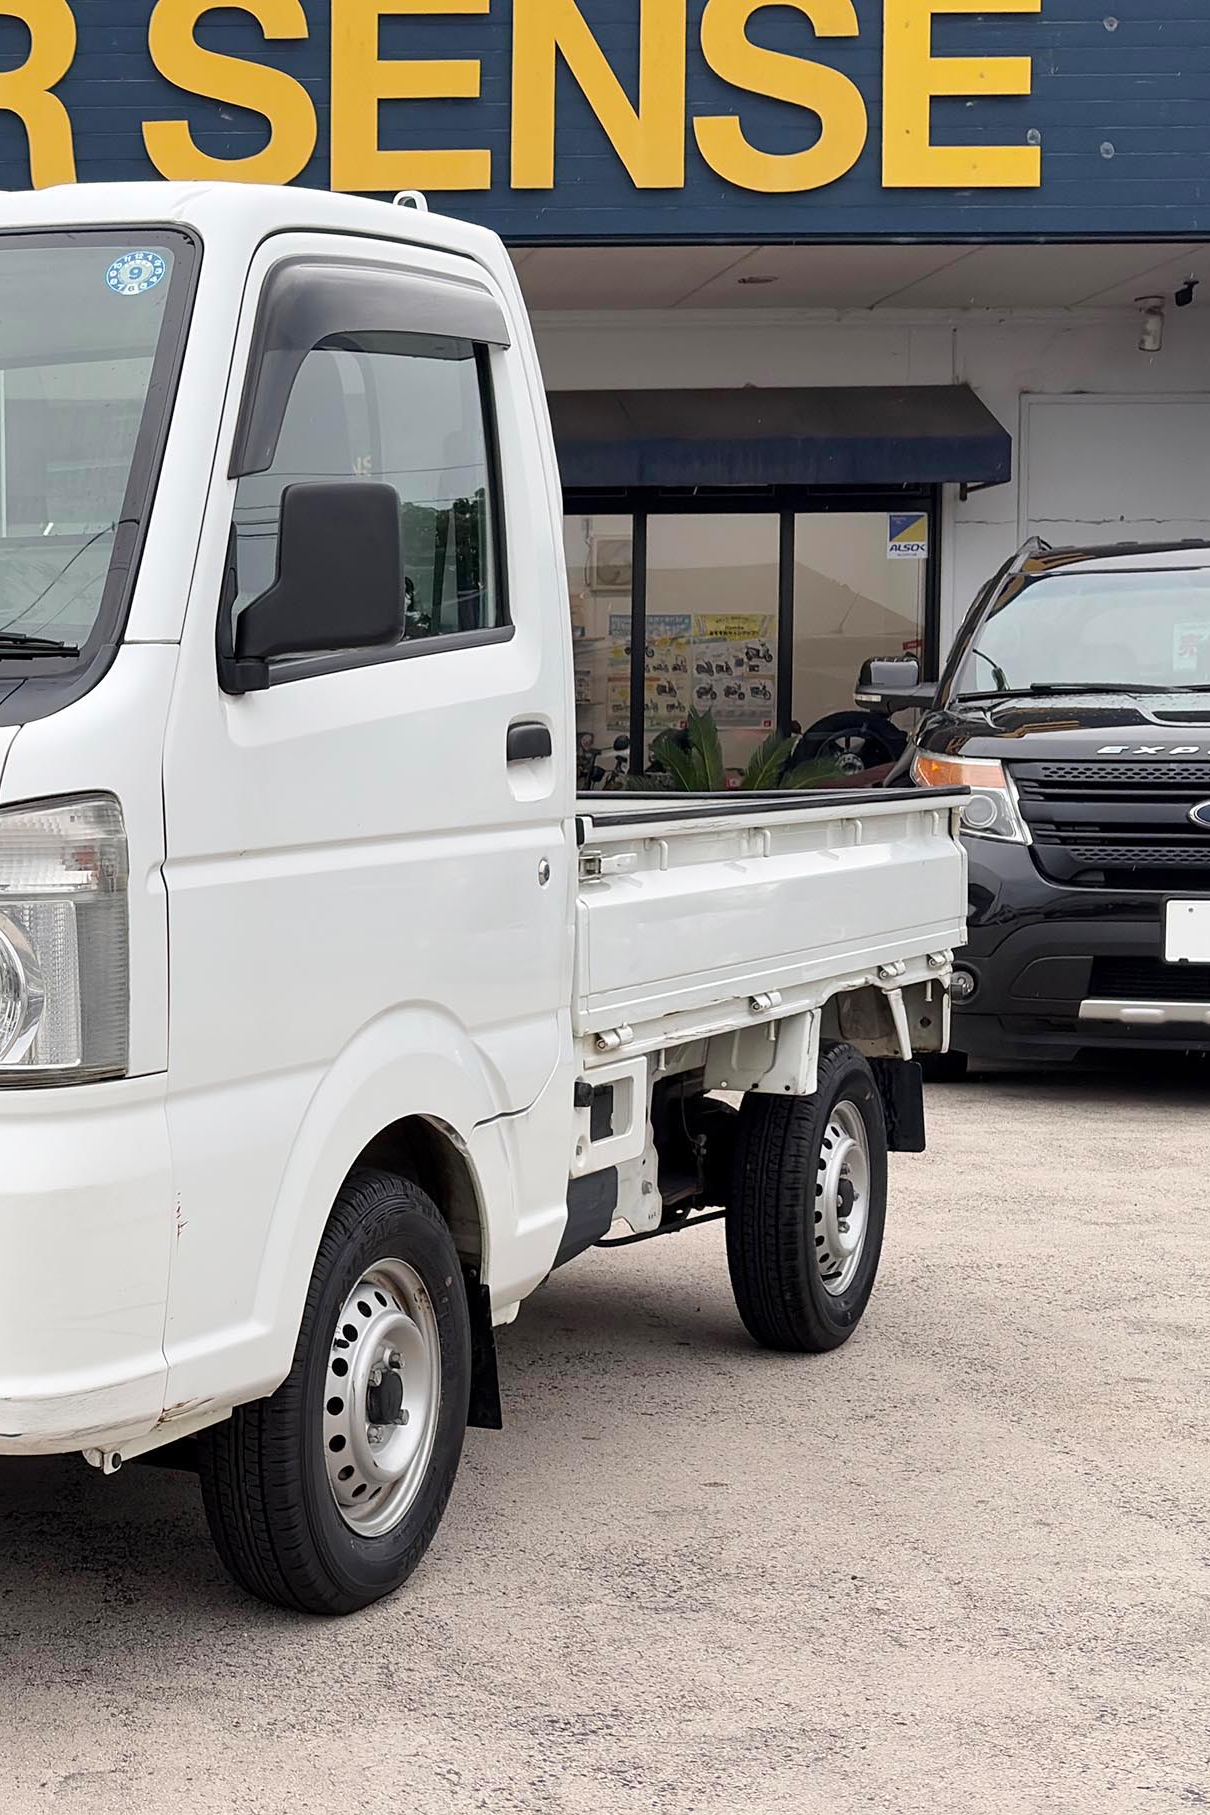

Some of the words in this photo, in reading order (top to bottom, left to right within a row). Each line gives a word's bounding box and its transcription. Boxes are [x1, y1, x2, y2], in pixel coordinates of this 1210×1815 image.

[142, 0, 1041, 192] SENSE
[129, 266, 143, 280] 9
[889, 543, 926, 552] ALSOK
[1096, 745, 1210, 755] EXP
